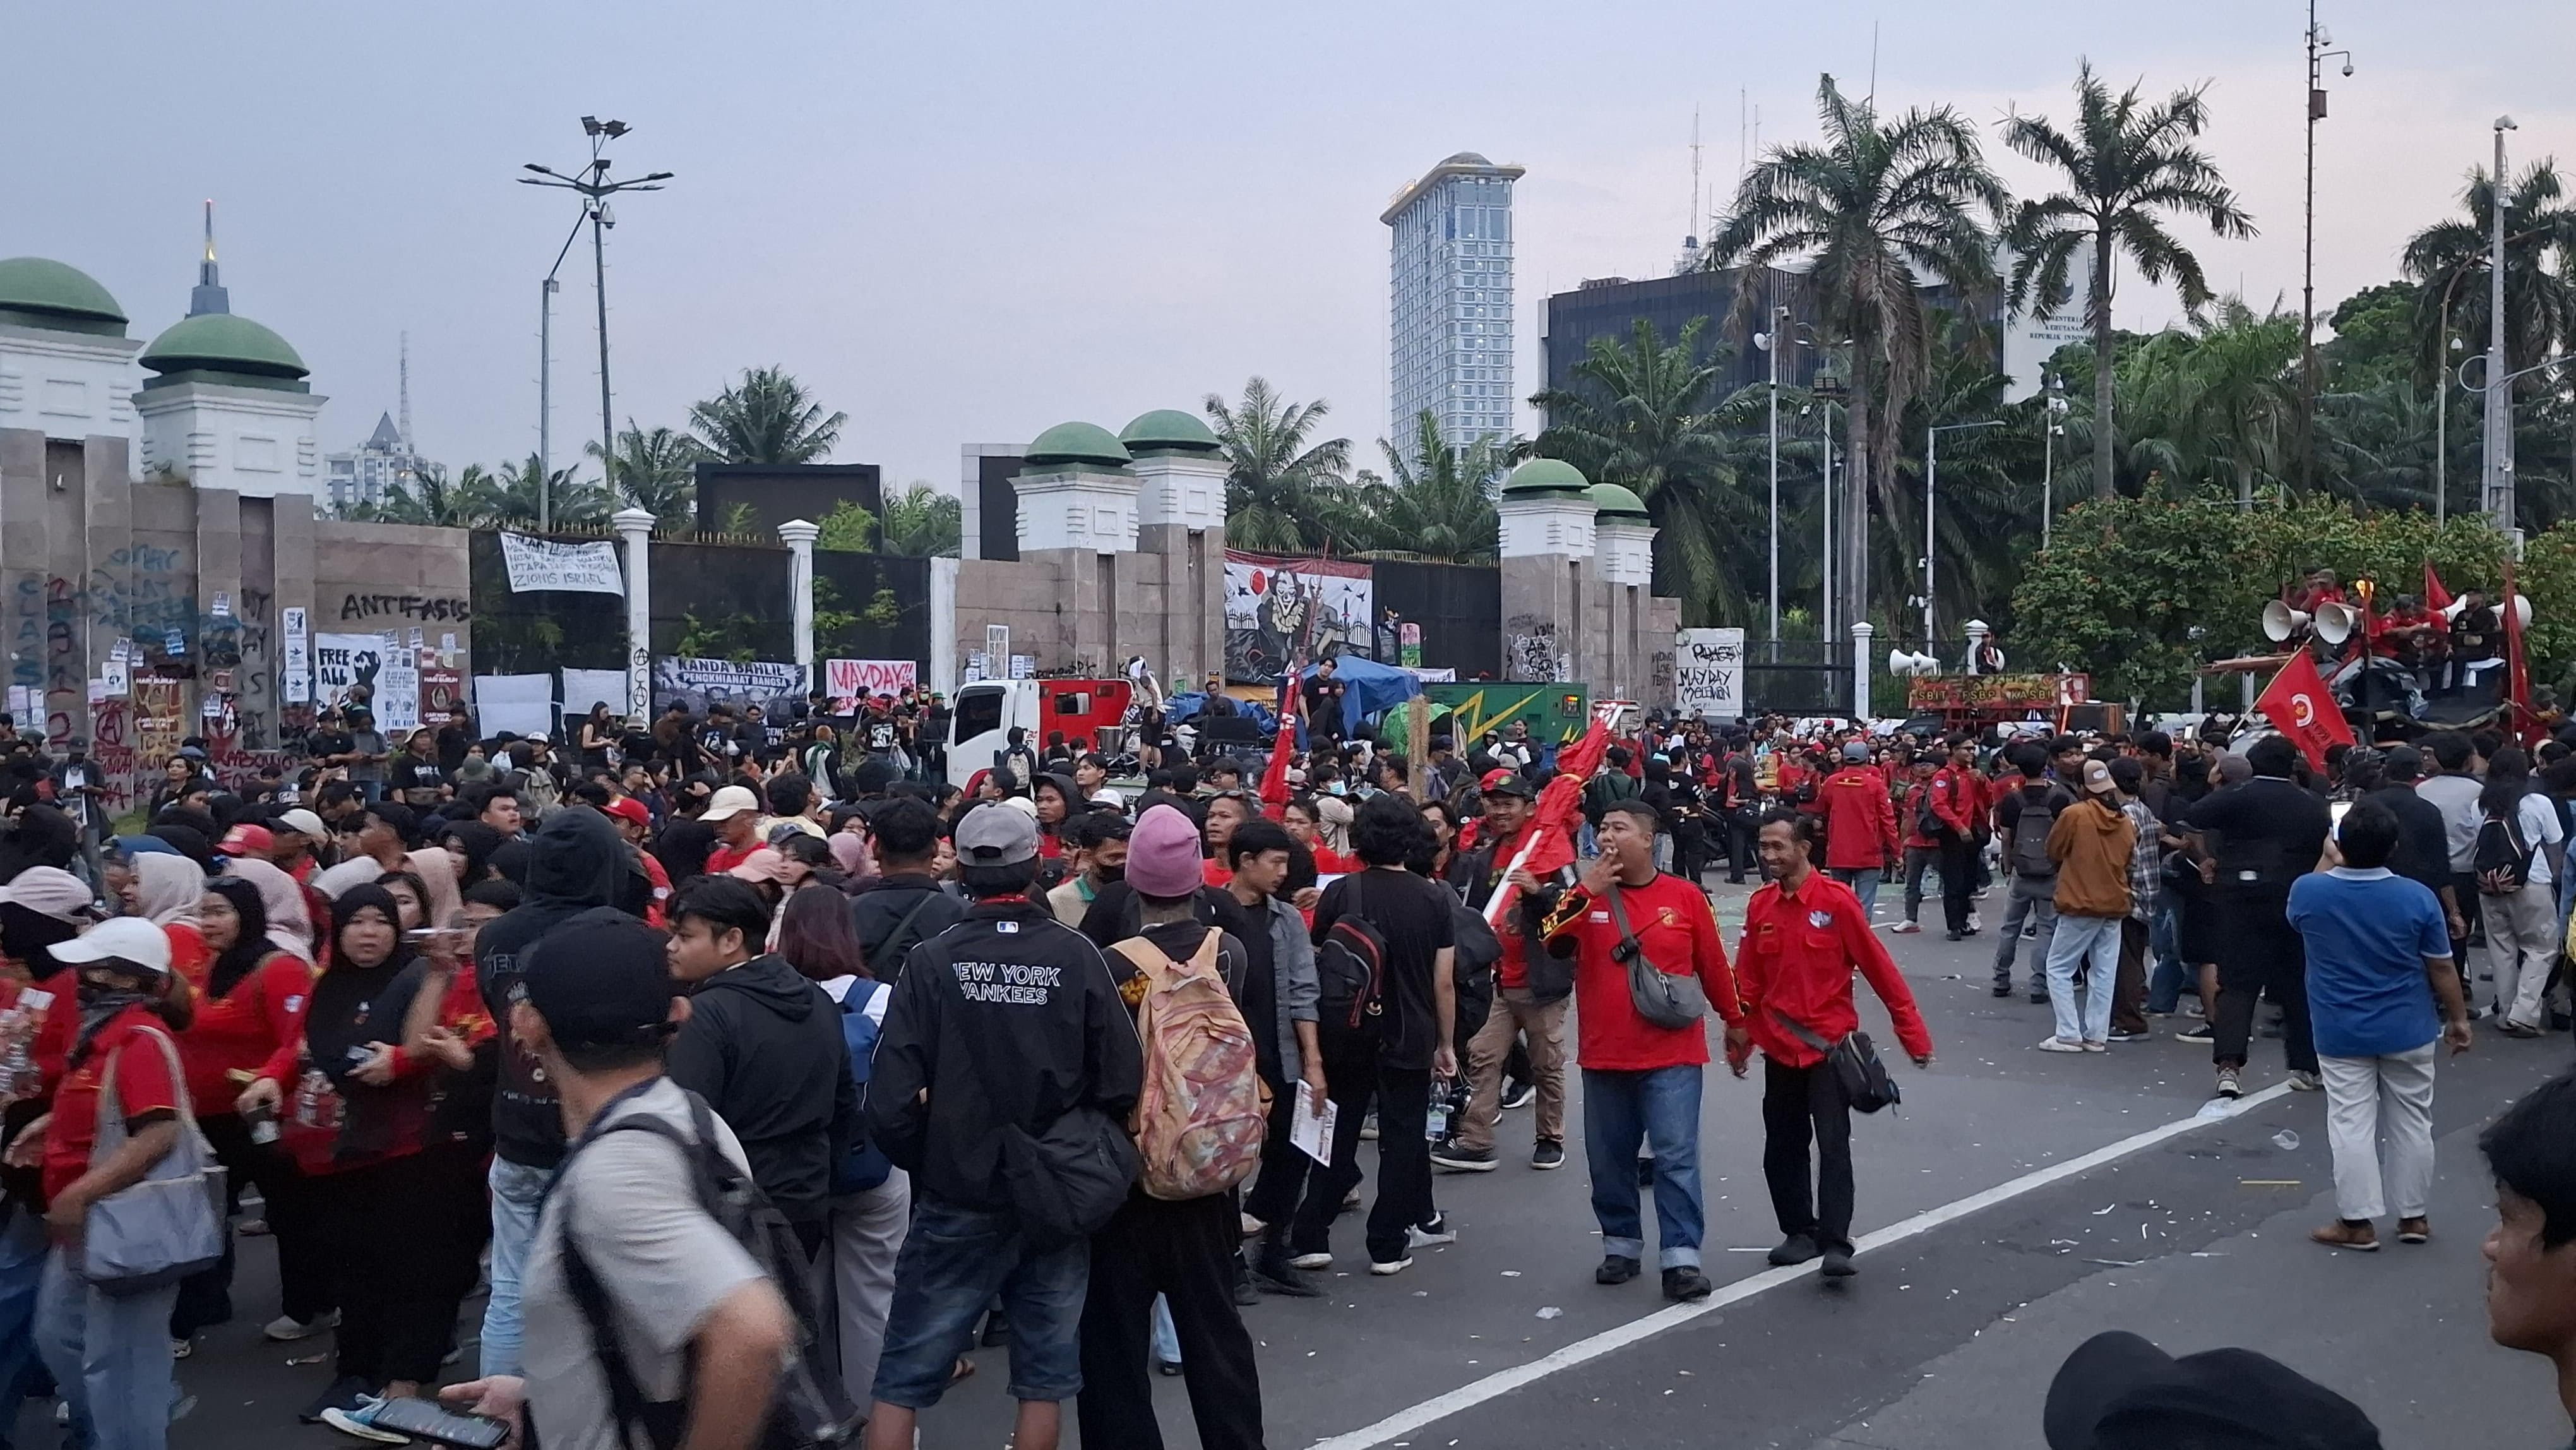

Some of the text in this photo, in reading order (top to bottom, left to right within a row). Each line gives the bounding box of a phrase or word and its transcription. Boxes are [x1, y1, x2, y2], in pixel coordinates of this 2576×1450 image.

[318, 648, 350, 666] FREE
[677, 659, 729, 673] KANDA
[321, 667, 348, 685] ALL
[683, 672, 787, 688] PENGKHIANAT BANGSA
[2012, 689, 2051, 701] KASBI
[1000, 963, 1061, 987] YORK
[960, 981, 1048, 1005] YANKEES
